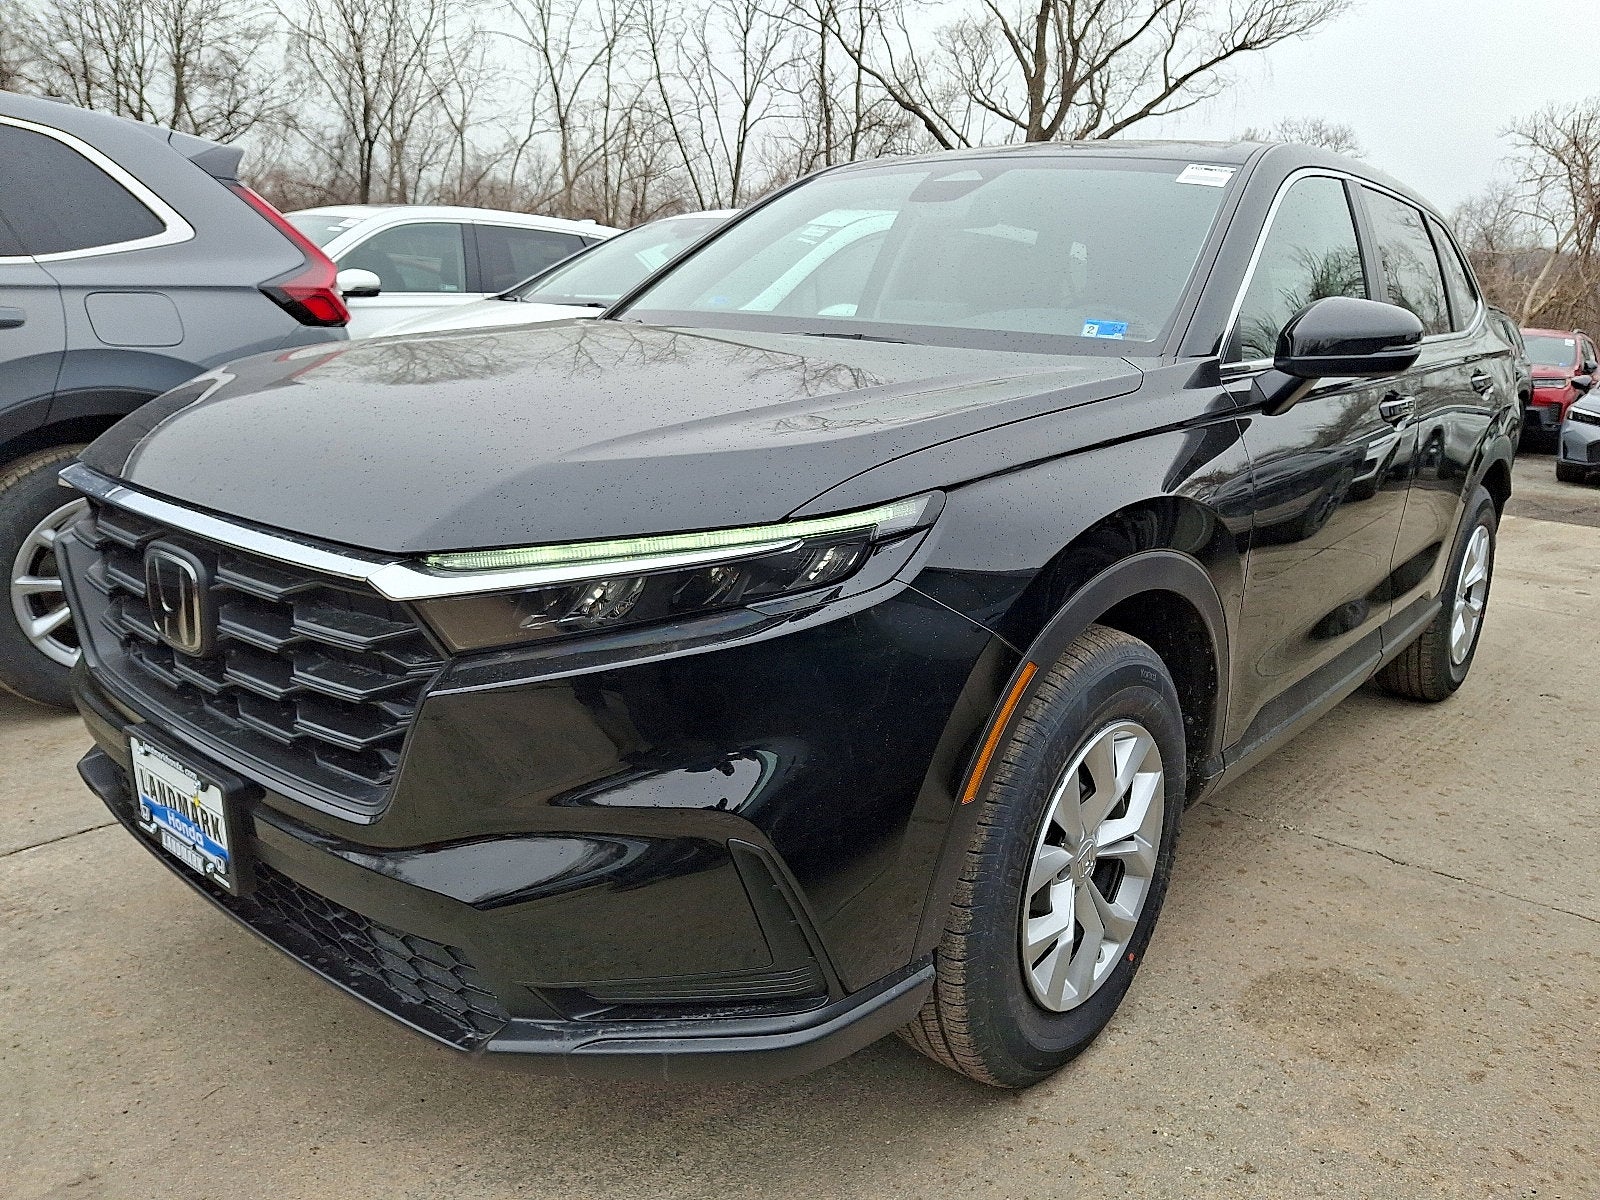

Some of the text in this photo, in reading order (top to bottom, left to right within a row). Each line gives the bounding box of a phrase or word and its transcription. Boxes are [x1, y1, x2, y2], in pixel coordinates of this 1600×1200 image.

[1086, 325, 1095, 334] 2
[139, 768, 225, 848] LANDMARK
[167, 809, 204, 846] Honda
